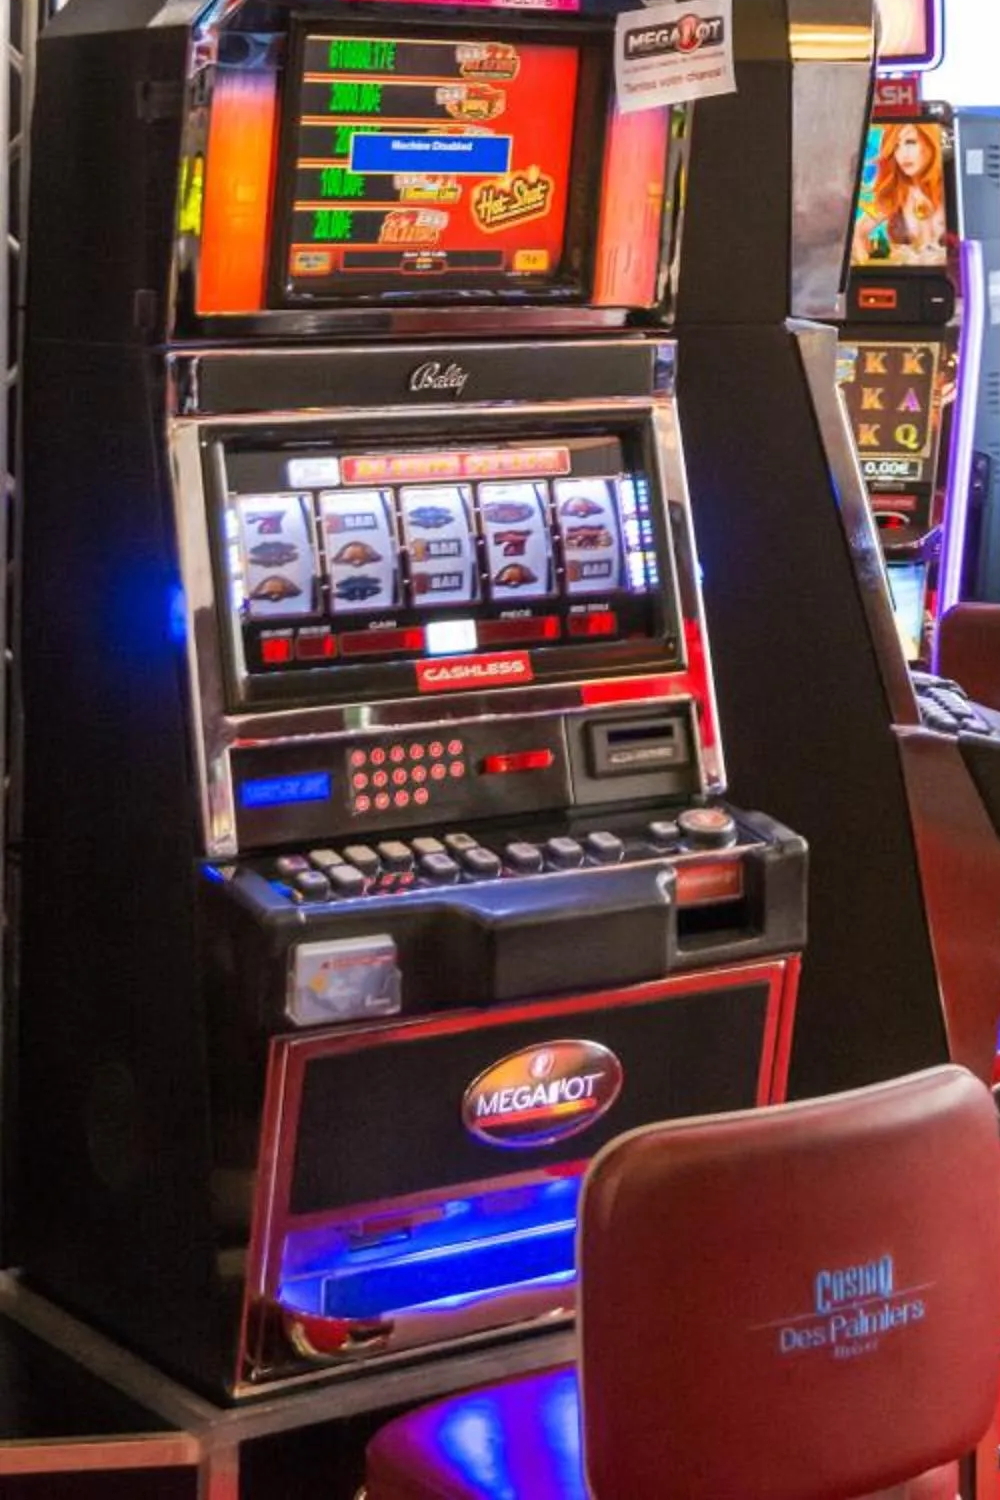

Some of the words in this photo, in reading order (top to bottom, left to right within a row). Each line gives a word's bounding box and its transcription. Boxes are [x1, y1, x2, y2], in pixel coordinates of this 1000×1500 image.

[864, 351, 887, 374] K
[410, 360, 470, 396] Bally
[860, 387, 884, 411] K
[423, 659, 525, 681] CASHLESS
[476, 1075, 596, 1117] MEGAPOT
[779, 1325, 826, 1354] Des
[829, 1300, 925, 1343] Palmiers
